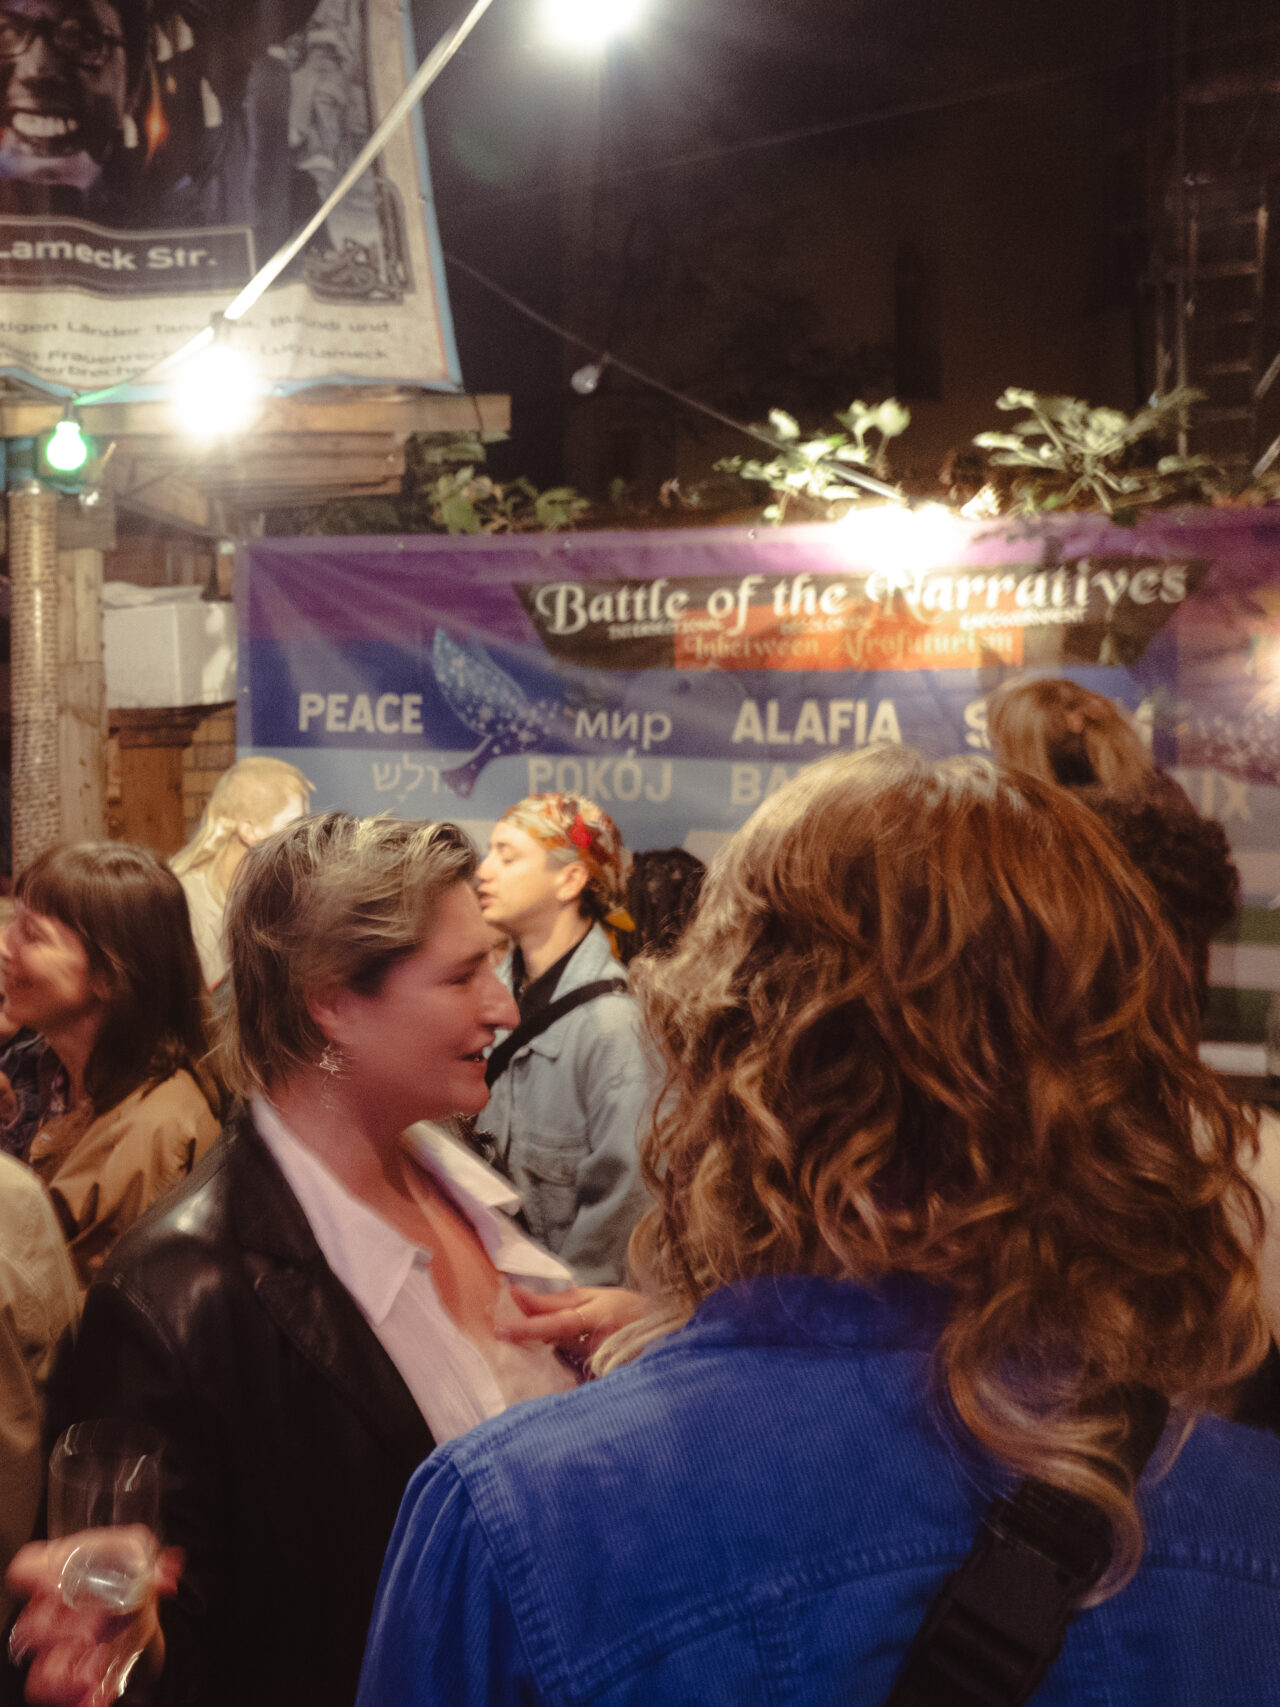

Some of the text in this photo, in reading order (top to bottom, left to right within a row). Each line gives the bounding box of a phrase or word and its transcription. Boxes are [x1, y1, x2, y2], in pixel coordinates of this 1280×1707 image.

[146, 245, 218, 268] Str.
[535, 578, 690, 635] Battle
[707, 573, 766, 637] of
[772, 573, 849, 616] the
[299, 693, 424, 734] PEACE
[574, 709, 673, 749] мир
[731, 698, 903, 745] ALAFIA
[528, 748, 674, 803] POKÓJ
